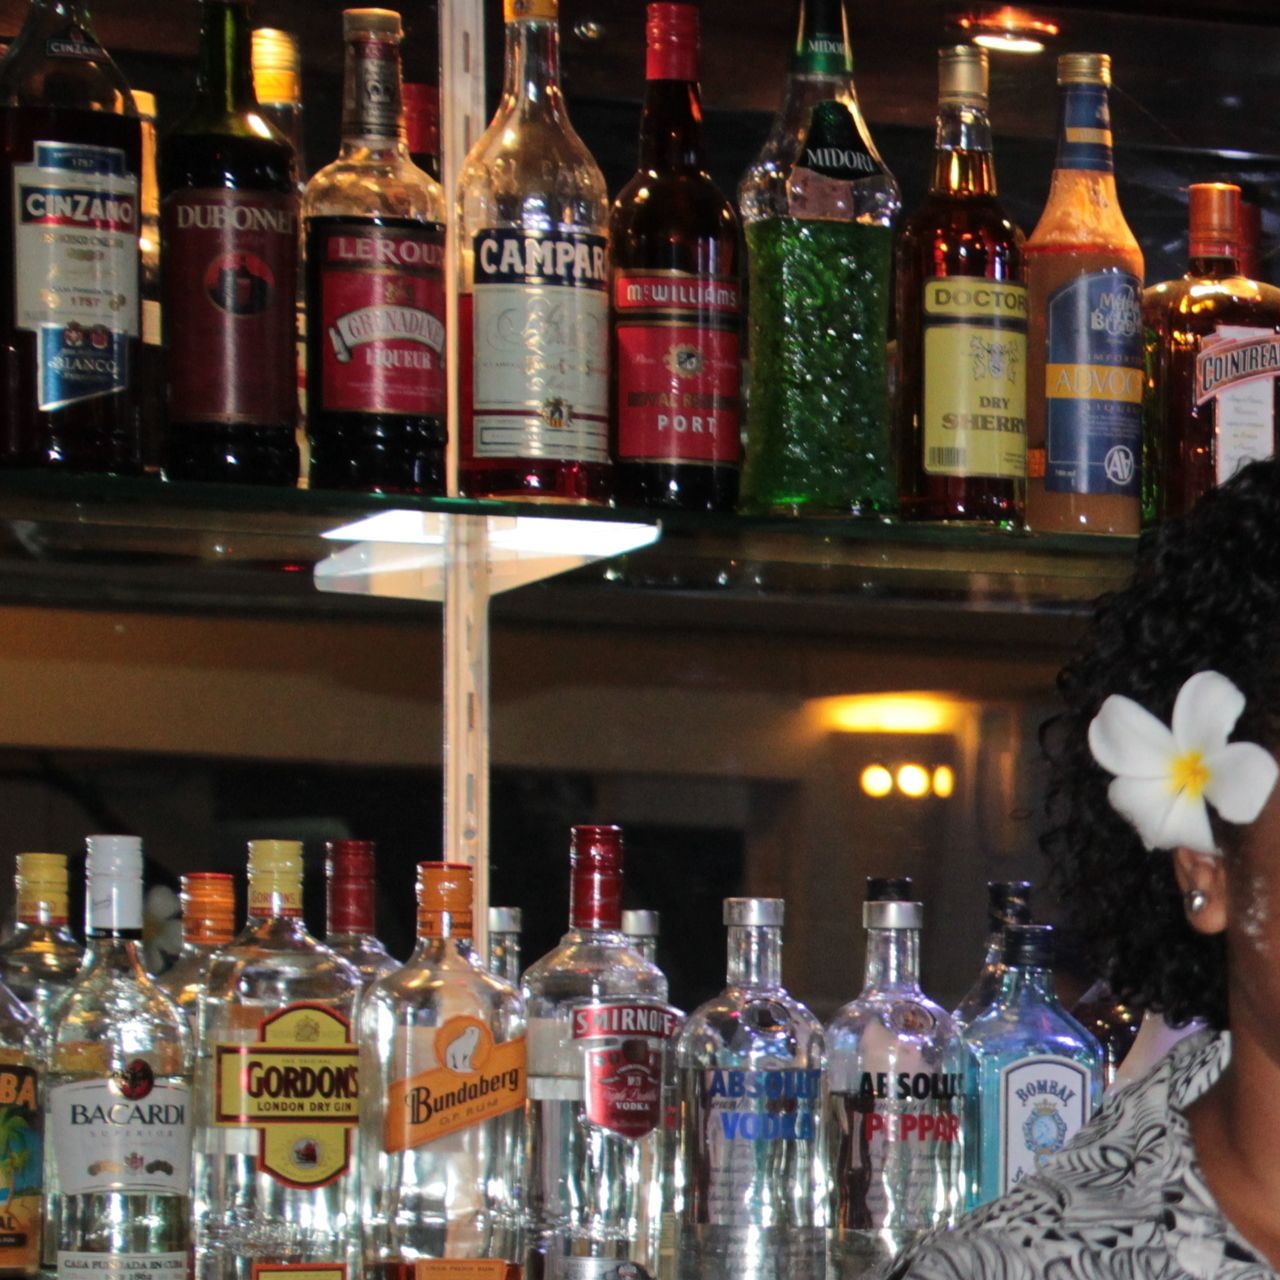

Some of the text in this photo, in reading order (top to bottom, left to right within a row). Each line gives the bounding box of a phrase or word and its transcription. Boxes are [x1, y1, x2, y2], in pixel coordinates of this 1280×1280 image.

[806, 147, 875, 172] MIDORI
[26, 193, 133, 223] CINZANO
[366, 347, 432, 369] LIQUEUR
[979, 395, 1010, 409] DRY
[657, 414, 717, 434] PORT
[711, 1069, 822, 1098] ABSOLUT
[1015, 1079, 1077, 1107] BOMBAY
[257, 1102, 352, 1112] LONDON DRY GIN
[405, 1068, 520, 1125] Bundaberg
[616, 1102, 650, 1111] VODKA
[70, 1103, 185, 1126] BACARDI
[720, 1112, 815, 1141] VODKA
[866, 1112, 961, 1142] PPPAR
